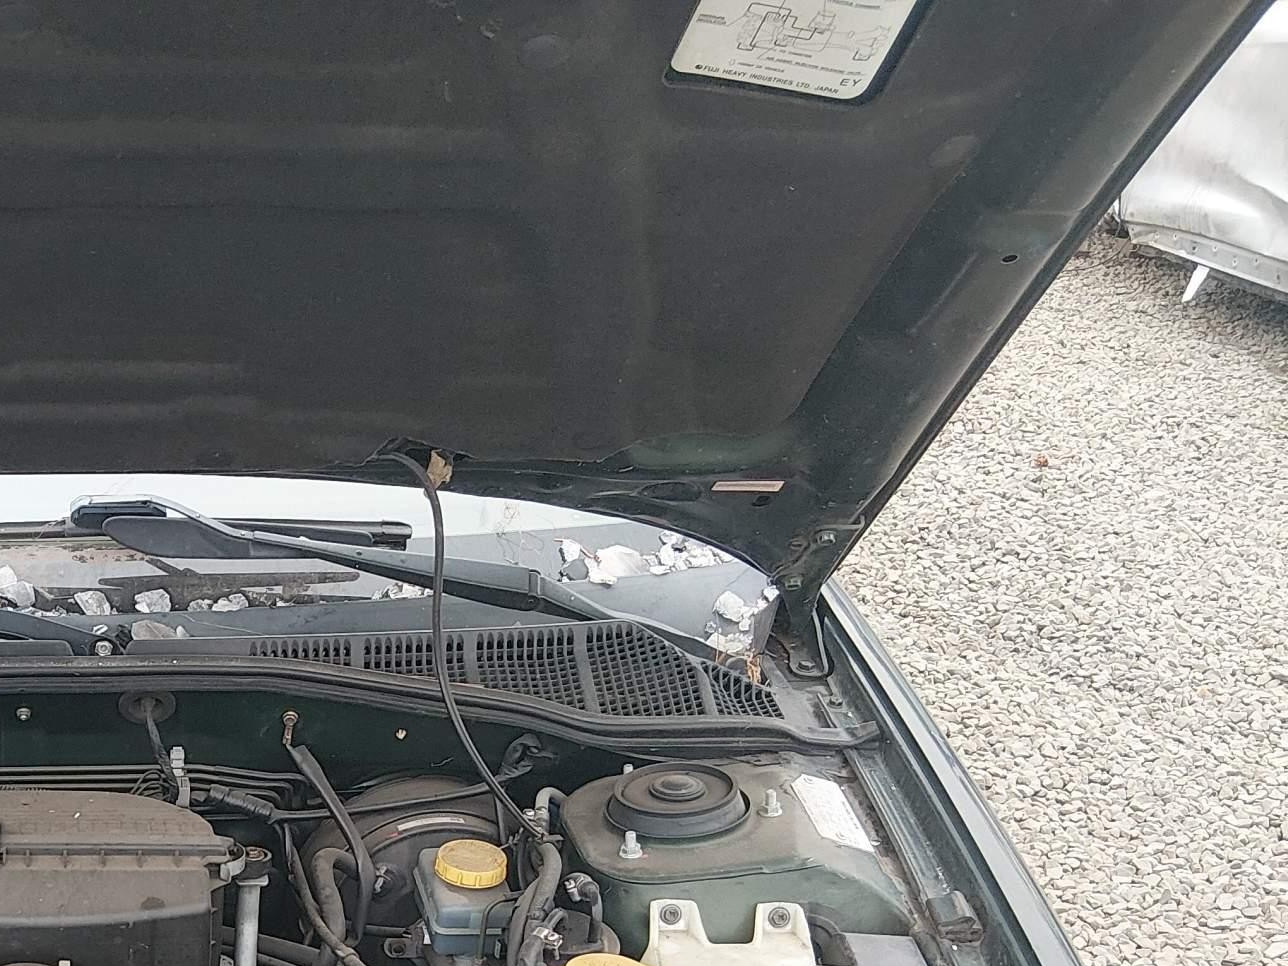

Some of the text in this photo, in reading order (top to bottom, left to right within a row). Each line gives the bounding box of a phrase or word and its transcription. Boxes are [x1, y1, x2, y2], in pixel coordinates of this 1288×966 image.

[703, 66, 720, 74] FUJI
[721, 68, 748, 78] HEAVY
[748, 73, 794, 87] INDUSTRIES
[814, 85, 840, 95] JAPAN
